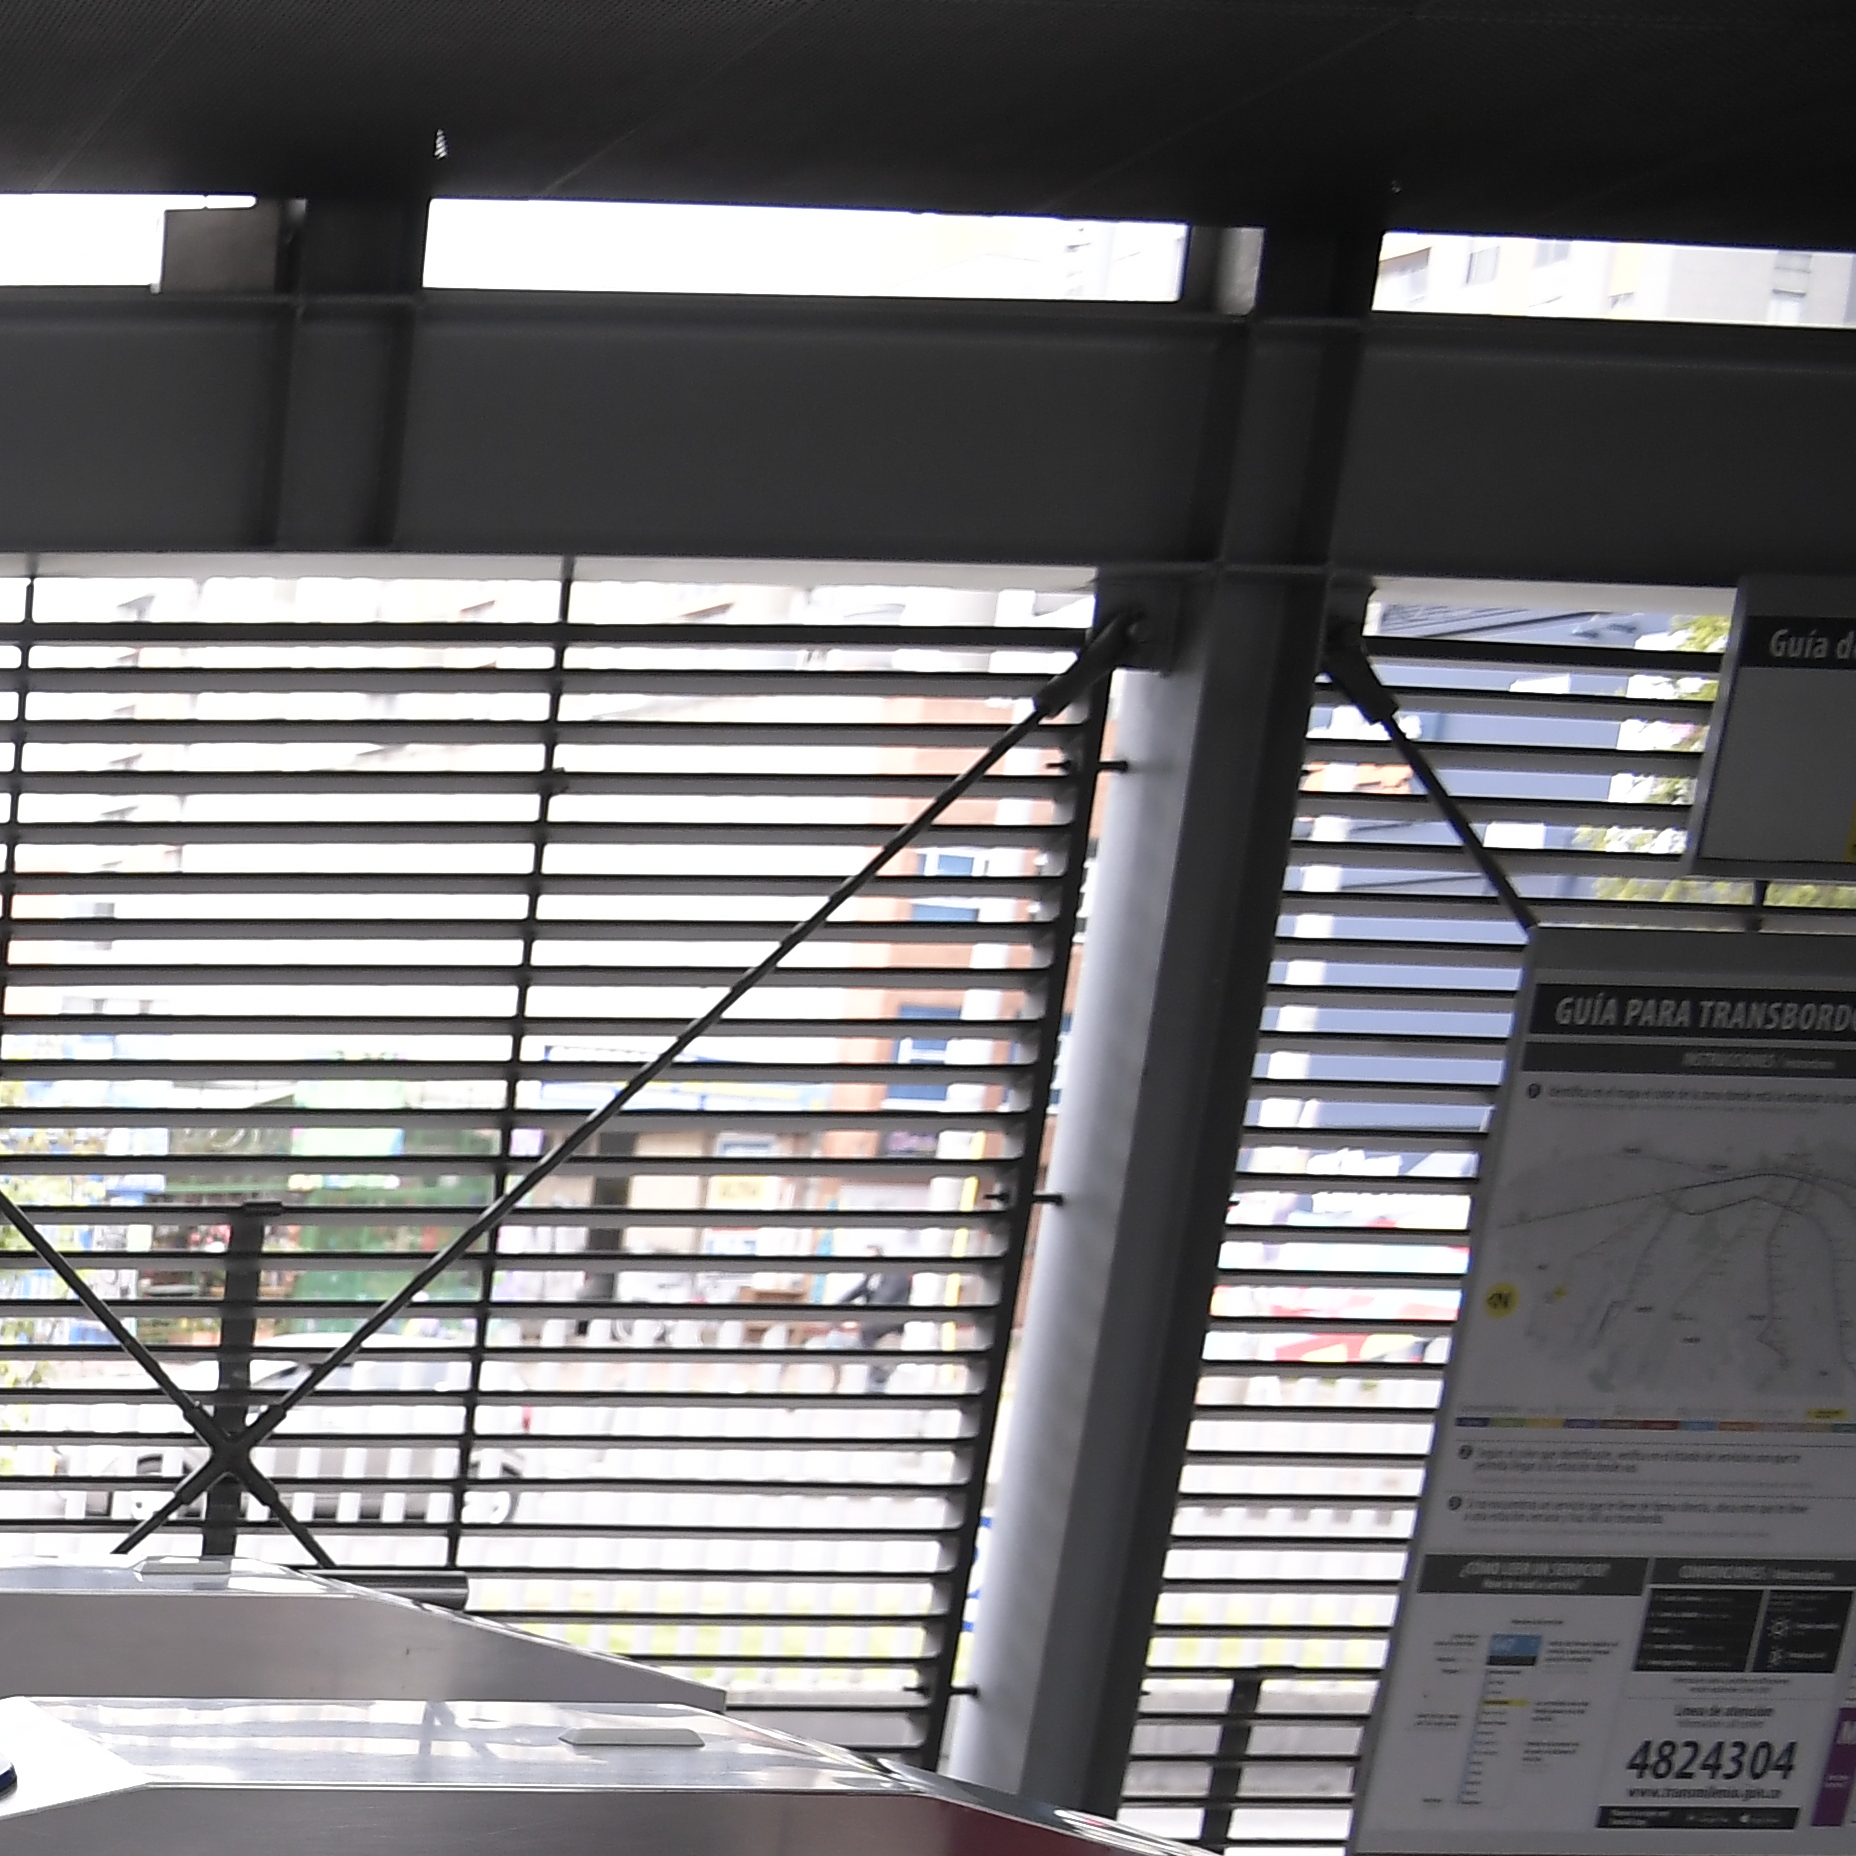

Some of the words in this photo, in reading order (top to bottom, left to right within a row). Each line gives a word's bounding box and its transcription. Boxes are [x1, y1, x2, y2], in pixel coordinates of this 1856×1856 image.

[1769, 628, 1829, 658] Guía
[1554, 992, 1619, 1027] GUÍA
[1623, 996, 1692, 1028] PARA
[1697, 1000, 1856, 1033] TRANSBORD
[1626, 1739, 1798, 1780] 4824304
